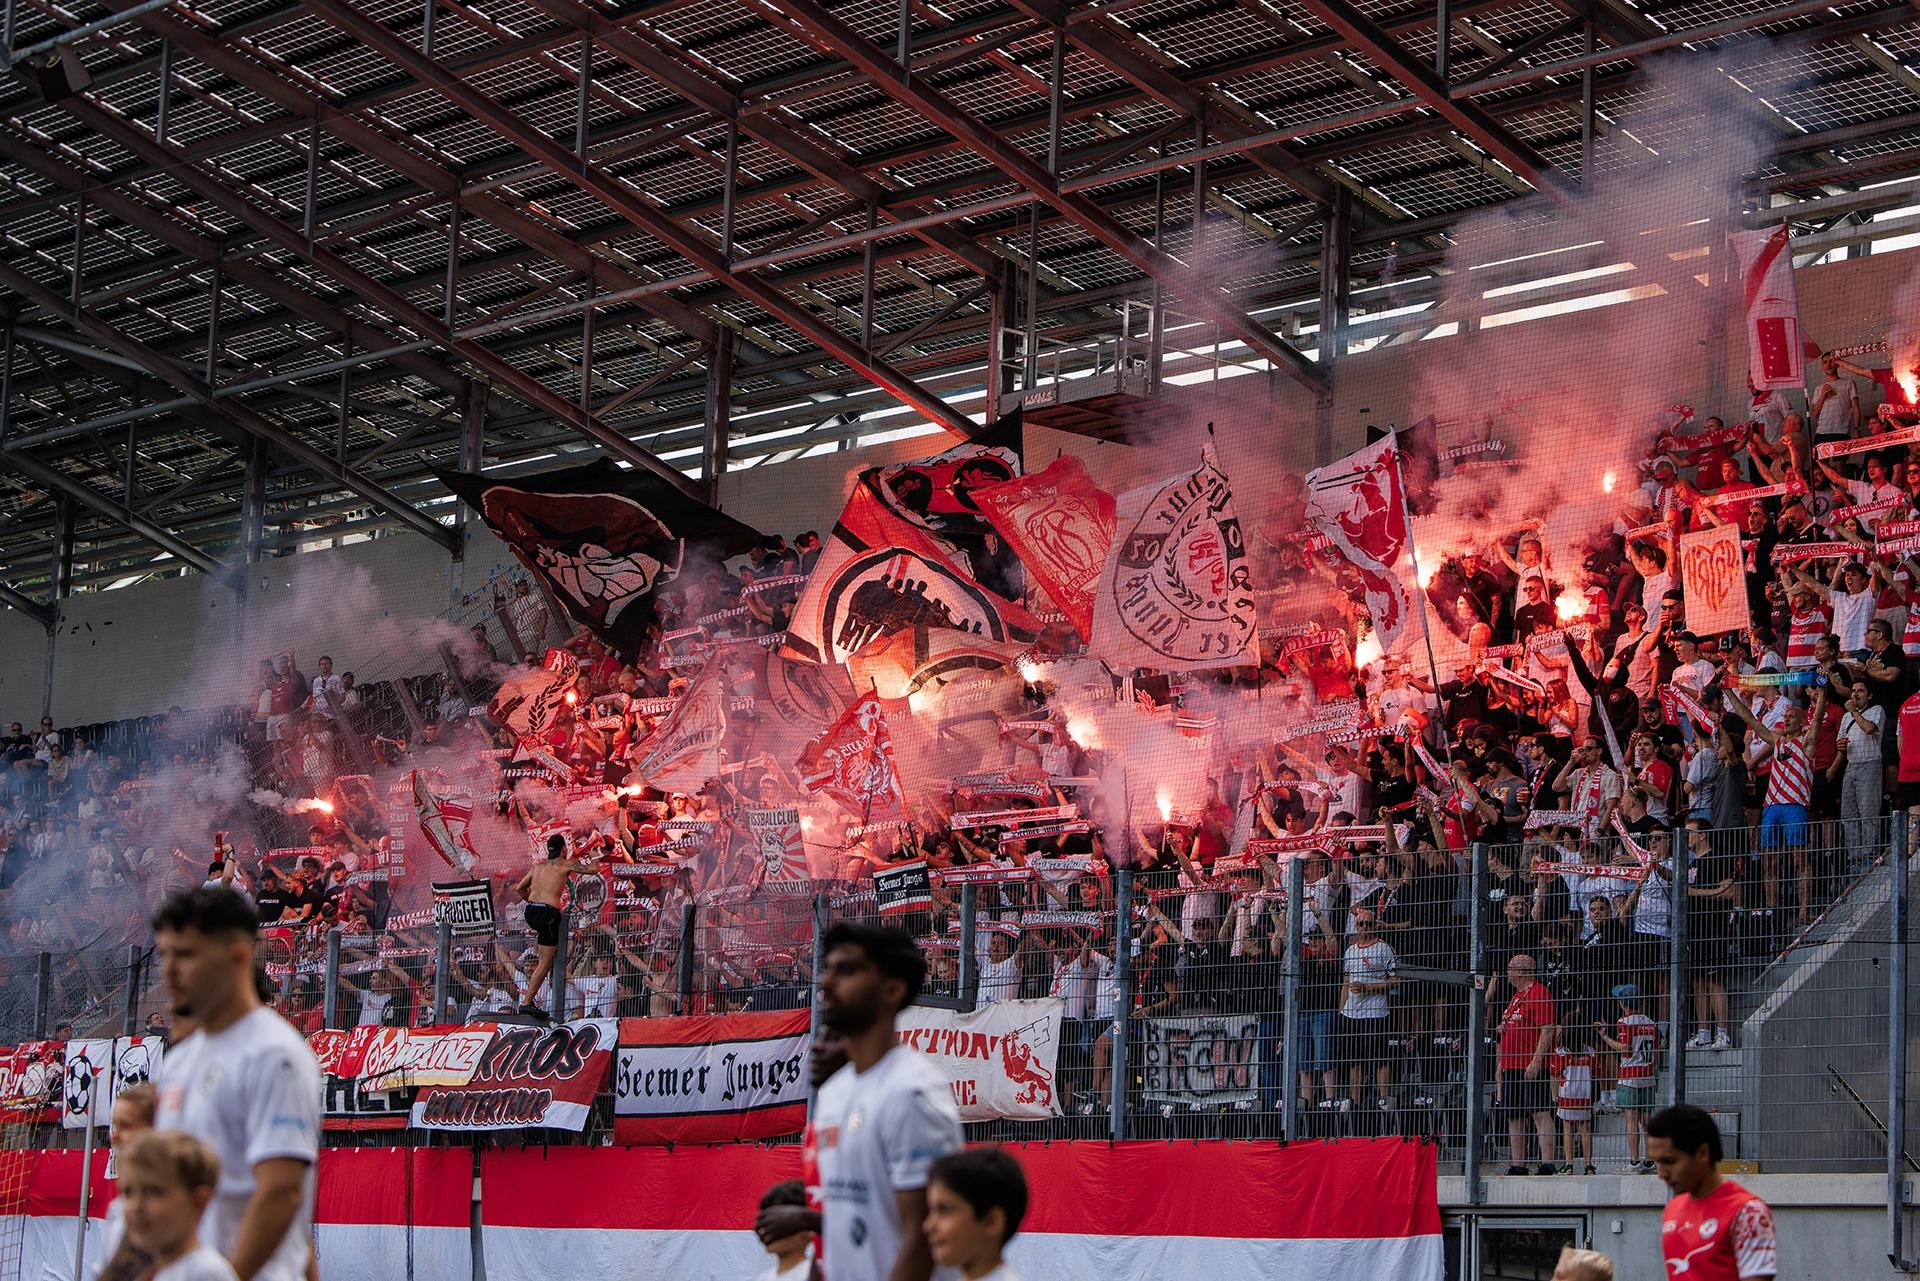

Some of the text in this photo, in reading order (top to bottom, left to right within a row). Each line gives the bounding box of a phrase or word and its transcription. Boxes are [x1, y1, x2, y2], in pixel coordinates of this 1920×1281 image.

[1839, 496, 1899, 519] FC WINTERTHUR
[1879, 526, 1889, 537] FC
[879, 874, 923, 892] Seemer Jungs
[474, 1025, 602, 1081] KTLOS
[617, 1052, 804, 1101] Seemer Jungs
[422, 1088, 553, 1125] WINTERTHUR
